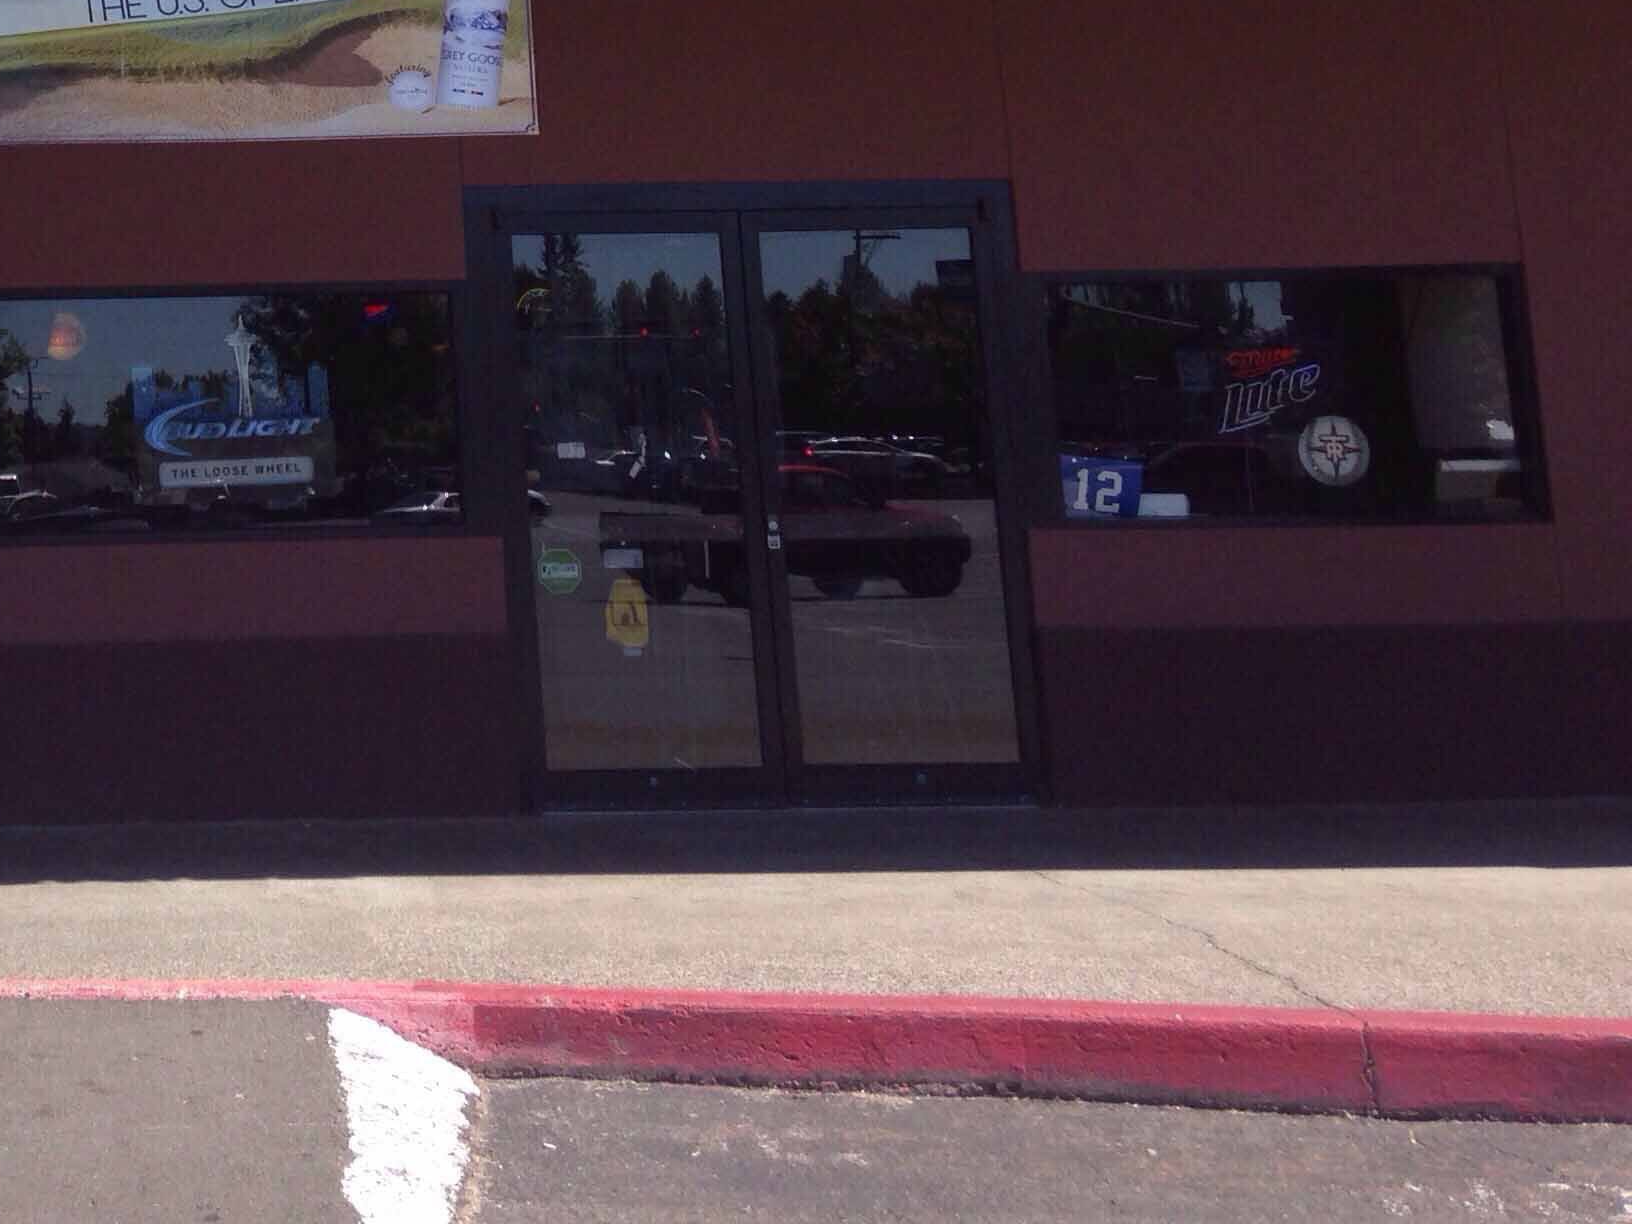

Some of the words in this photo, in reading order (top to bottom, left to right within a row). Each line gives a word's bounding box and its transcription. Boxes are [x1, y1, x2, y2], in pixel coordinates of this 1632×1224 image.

[172, 468, 198, 480] THE
[204, 465, 249, 478] LOOSE
[255, 462, 303, 475] WHEEL
[1072, 468, 1124, 514] 12
